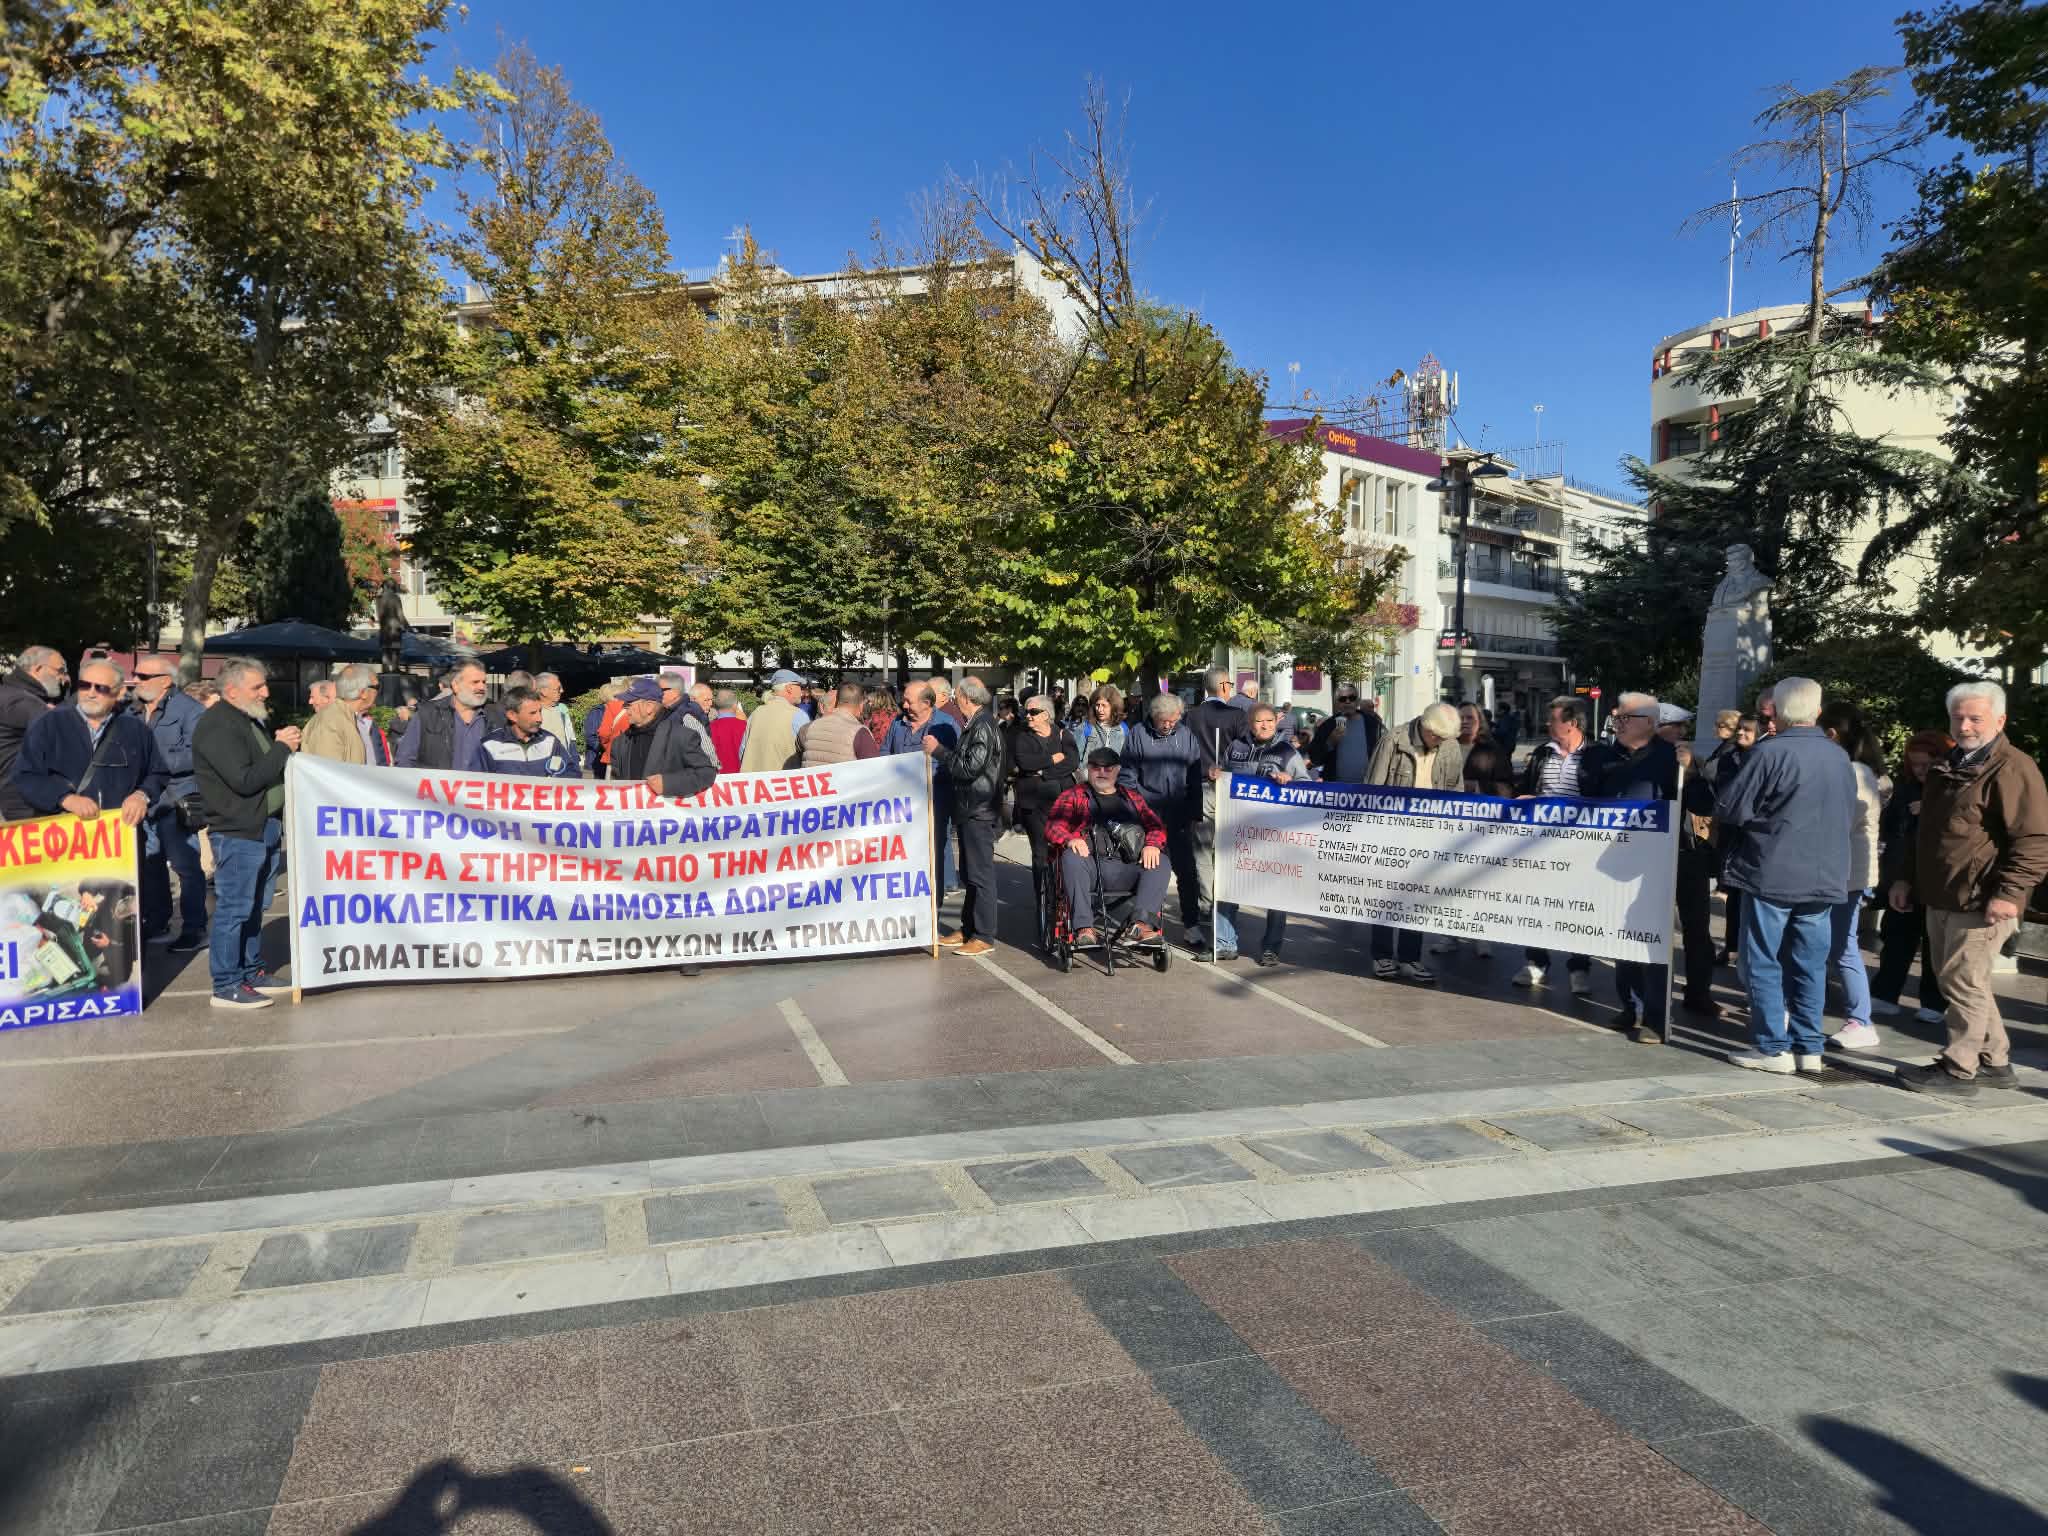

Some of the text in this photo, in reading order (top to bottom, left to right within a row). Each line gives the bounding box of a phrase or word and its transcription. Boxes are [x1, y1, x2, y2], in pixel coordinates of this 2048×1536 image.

[1328, 430, 1356, 447] Optima
[417, 778, 585, 811] ΑΥΞΗΣΕΙΣ
[1236, 783, 1274, 801] Σ.Ε.Α.
[1279, 788, 1405, 812] ΣΥΝΤΑΞΙΟΥΧΙΚΩΝ
[1409, 797, 1503, 819] ΣΩΜΑΤΕΙΩΝ
[1533, 804, 1657, 829] ΚΑΡΔΙΤΣΑΣ
[316, 796, 913, 849] ΕΠΙΣΤΡΟΦΗ ΤΩΝ ΠΑΡΑΚΡΑΤΗΘΕΝΤΩΝ
[1322, 822, 1352, 833] ΟΛΟΥΣ
[1324, 811, 1363, 823] ΑΥΞΗΣΕΙΣ
[1366, 814, 1385, 825] ΣΤΙΣ
[1387, 816, 1434, 829] ΣΥΝΤΑΞΕΙΣ
[1457, 821, 1464, 831] &
[1540, 828, 1612, 842] ΑΝΑΔΡΟΜΙΚΑ
[1617, 832, 1630, 843] ΣΕ
[0, 818, 122, 867] ΚΕΦΑΛΙ
[325, 834, 909, 883] ΜΕΤΡΑ ΣΤΗΡΙΞΗΣ ΑΠΟ ΤΗΝ ΑΚΡΙΒΕΙΑ
[1317, 850, 1411, 869] ΣΥΝΤΑΞΙΜΟΥ ΜΙΣΘΟΥ
[1318, 840, 1358, 852] ΣΥΝΤΑΞΗ
[1361, 843, 1378, 854] ΣΤΟ
[1381, 847, 1406, 857] ΜΕΣΟ
[1409, 848, 1430, 859] ΟΡΟ
[1433, 850, 1450, 862] ΤΗΣ
[1453, 852, 1508, 867] ΤΕΛΕΥΤΑΙΑΣ
[1550, 861, 1571, 872] ΤΟΥ
[300, 870, 931, 928] ΑΠΟΚΛΕΙΣΤΙΚΑ ΔΗΜΟΣΙΑ ΔΩΡΕΑΝ ΥΓΕΙΑ
[1318, 873, 1595, 912] ΚΑΤΑΡΓΗΣΗ ΤΗΣ ΕΙΣΦΟΡΑΣ ΑΛΛΗΛΕΓΓΥΗΣ ΚΑΙ ΓΙΑ ΤΗΝ ΥΓΕΙΑ
[1320, 891, 1345, 903] ΛΕΦΤΑ
[1348, 895, 1360, 905] ΓΙΑ
[1363, 897, 1404, 911] ΜΙΣΘΟΥΣ
[1413, 903, 1463, 919] ΣΥΝΤΑΞΕΙΣ
[1473, 911, 1513, 925] ΔΩΡΕΑΝ
[1517, 915, 1543, 929] ΥΓΕΙΑ
[1554, 921, 1604, 937] ΠΡΟΝΟΙΑ
[1617, 929, 1661, 944] ΠΑΙΔΕΙΑ
[1334, 904, 1348, 915] ΟΧΙ
[1351, 907, 1363, 917] ΓΙΑ
[1367, 908, 1382, 919] ΤΟΥ
[1385, 912, 1431, 925] ΠΟΛΕΜΟΥ
[1434, 918, 1443, 928] ΤΑ
[1447, 919, 1484, 934] ΣΦΑΓΕΙΑ
[321, 915, 917, 975] ΣΩΜΑΤΕΙΟ ΣΥΝΤΑΞΙΟΥΧΩΝ ΙΚΑ ΤΡΙΚΑΛΩΝ
